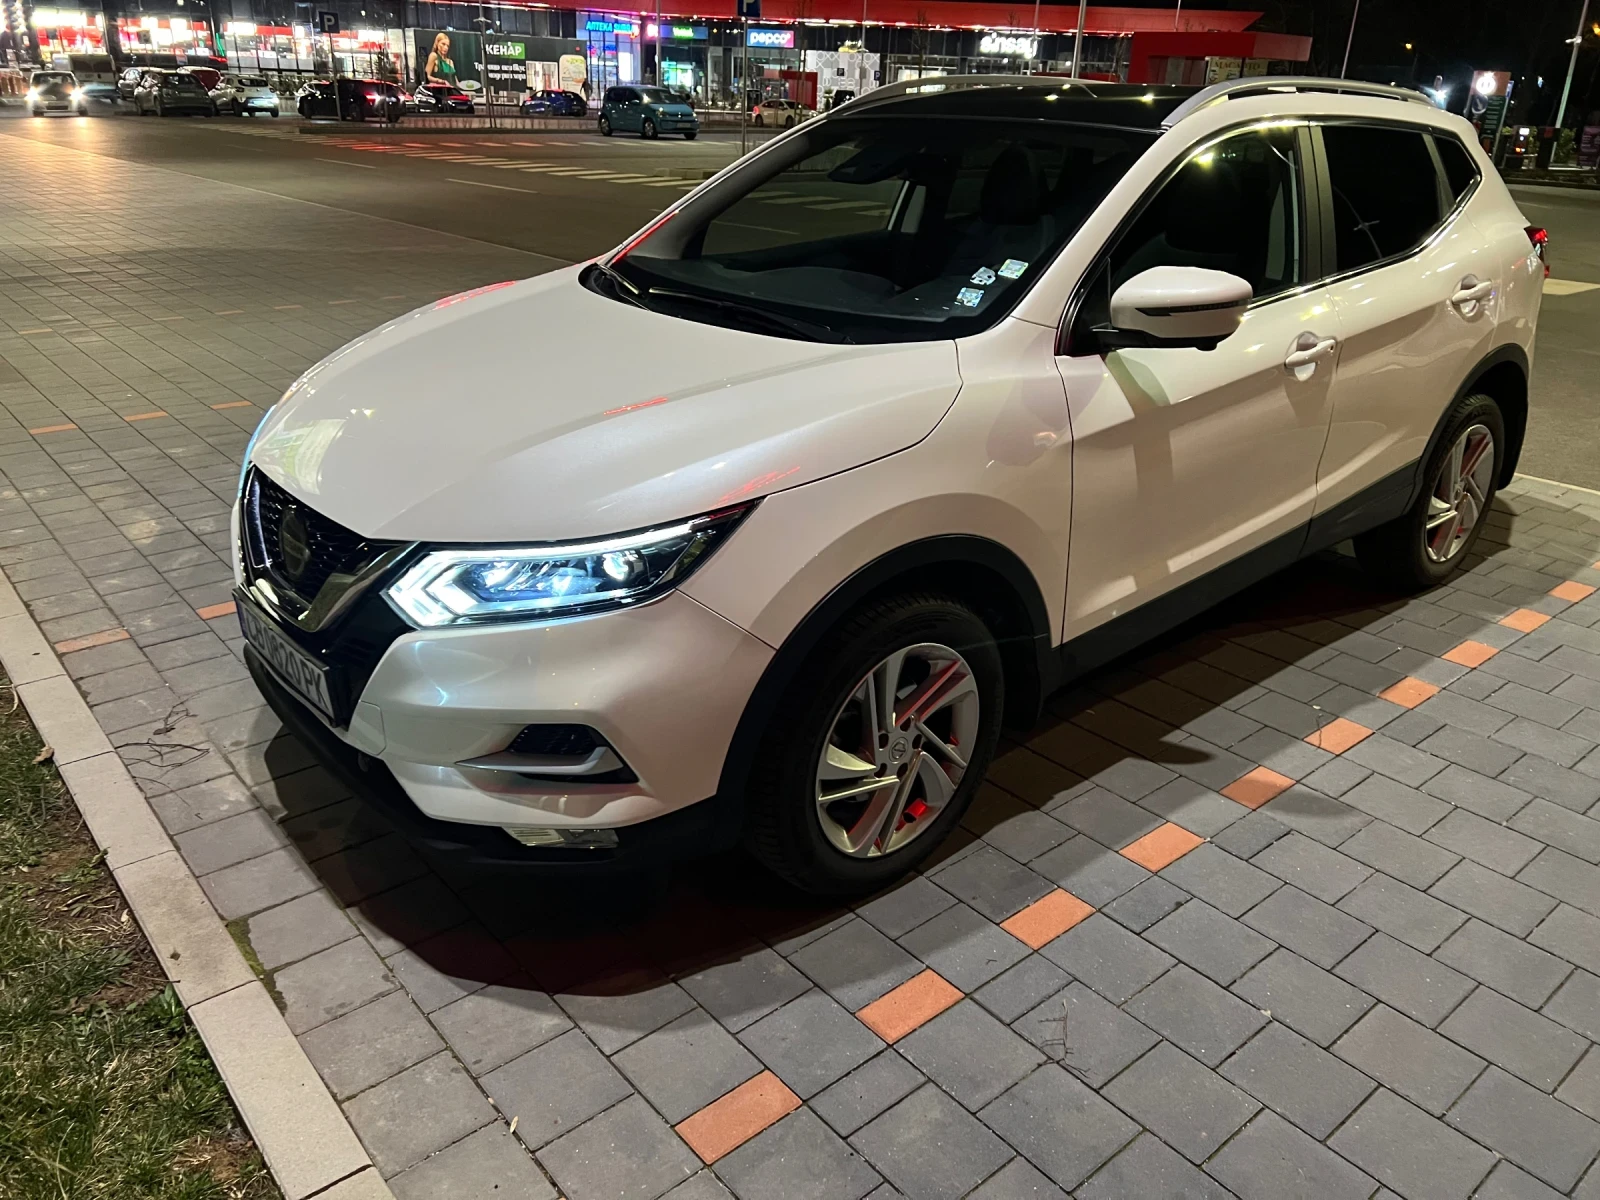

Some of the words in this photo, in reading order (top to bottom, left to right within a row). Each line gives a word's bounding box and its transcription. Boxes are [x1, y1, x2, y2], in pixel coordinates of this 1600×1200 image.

[742, 0, 755, 13] P
[323, 14, 335, 31] P
[585, 21, 613, 32] АПТЕКА
[750, 32, 788, 45] pepco
